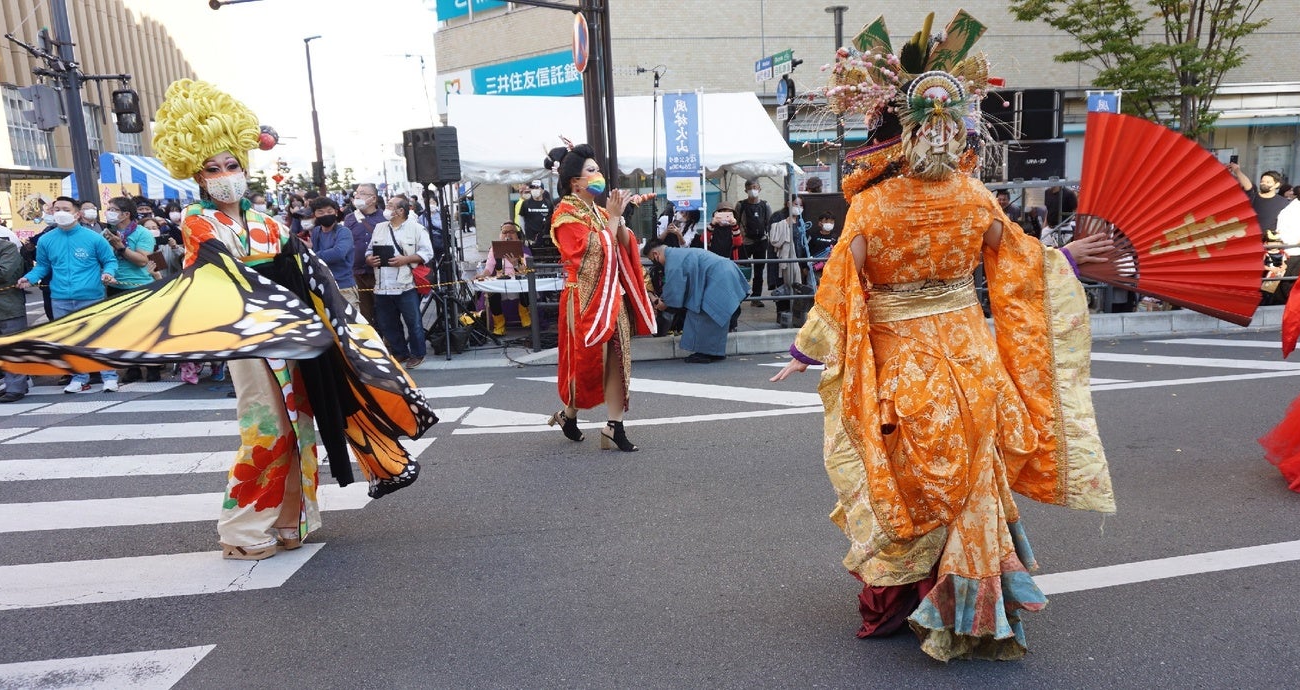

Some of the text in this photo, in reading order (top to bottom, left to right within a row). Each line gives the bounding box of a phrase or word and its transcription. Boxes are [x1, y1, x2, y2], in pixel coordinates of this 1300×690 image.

[485, 63, 583, 95] 三井住友信託銀
